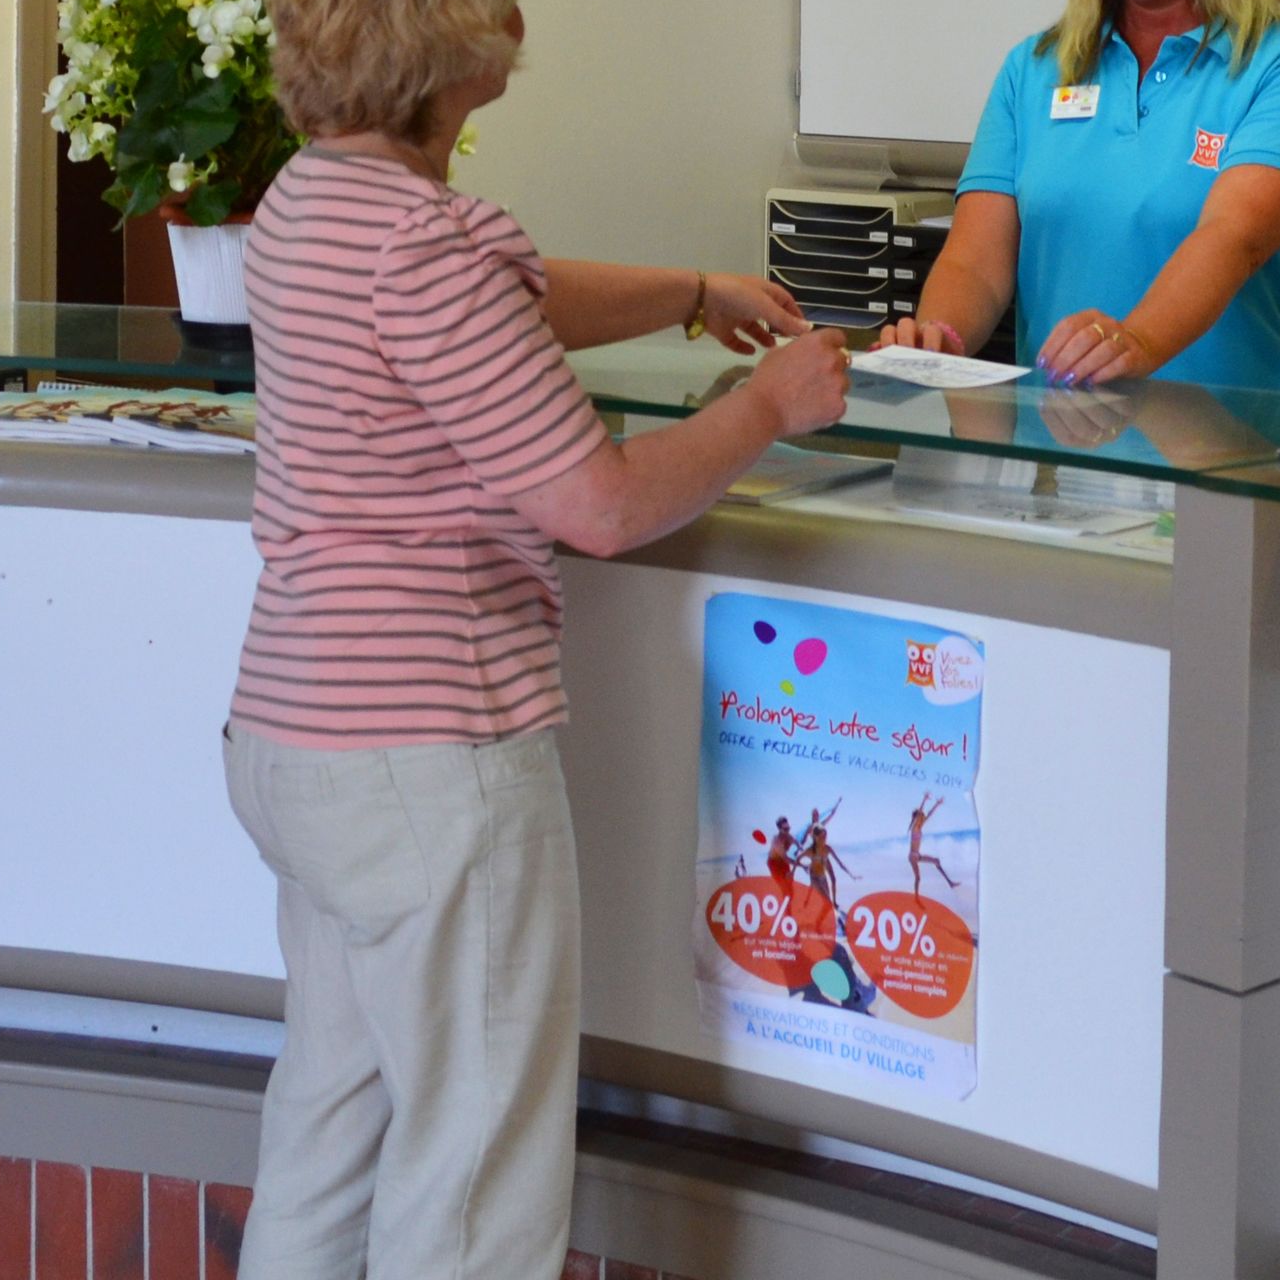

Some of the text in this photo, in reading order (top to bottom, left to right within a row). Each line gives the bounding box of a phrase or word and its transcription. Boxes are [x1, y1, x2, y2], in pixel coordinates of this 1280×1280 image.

[720, 690, 819, 737] Prolongez
[828, 711, 879, 741] votre
[892, 723, 954, 761] séjour
[849, 754, 927, 781] VACANCIERS
[711, 891, 798, 939] 40%
[853, 905, 936, 957] 20%
[840, 1042, 862, 1062] DU
[866, 1049, 926, 1081] VILLAGE
[851, 1026, 935, 1062] CONDITIONS
